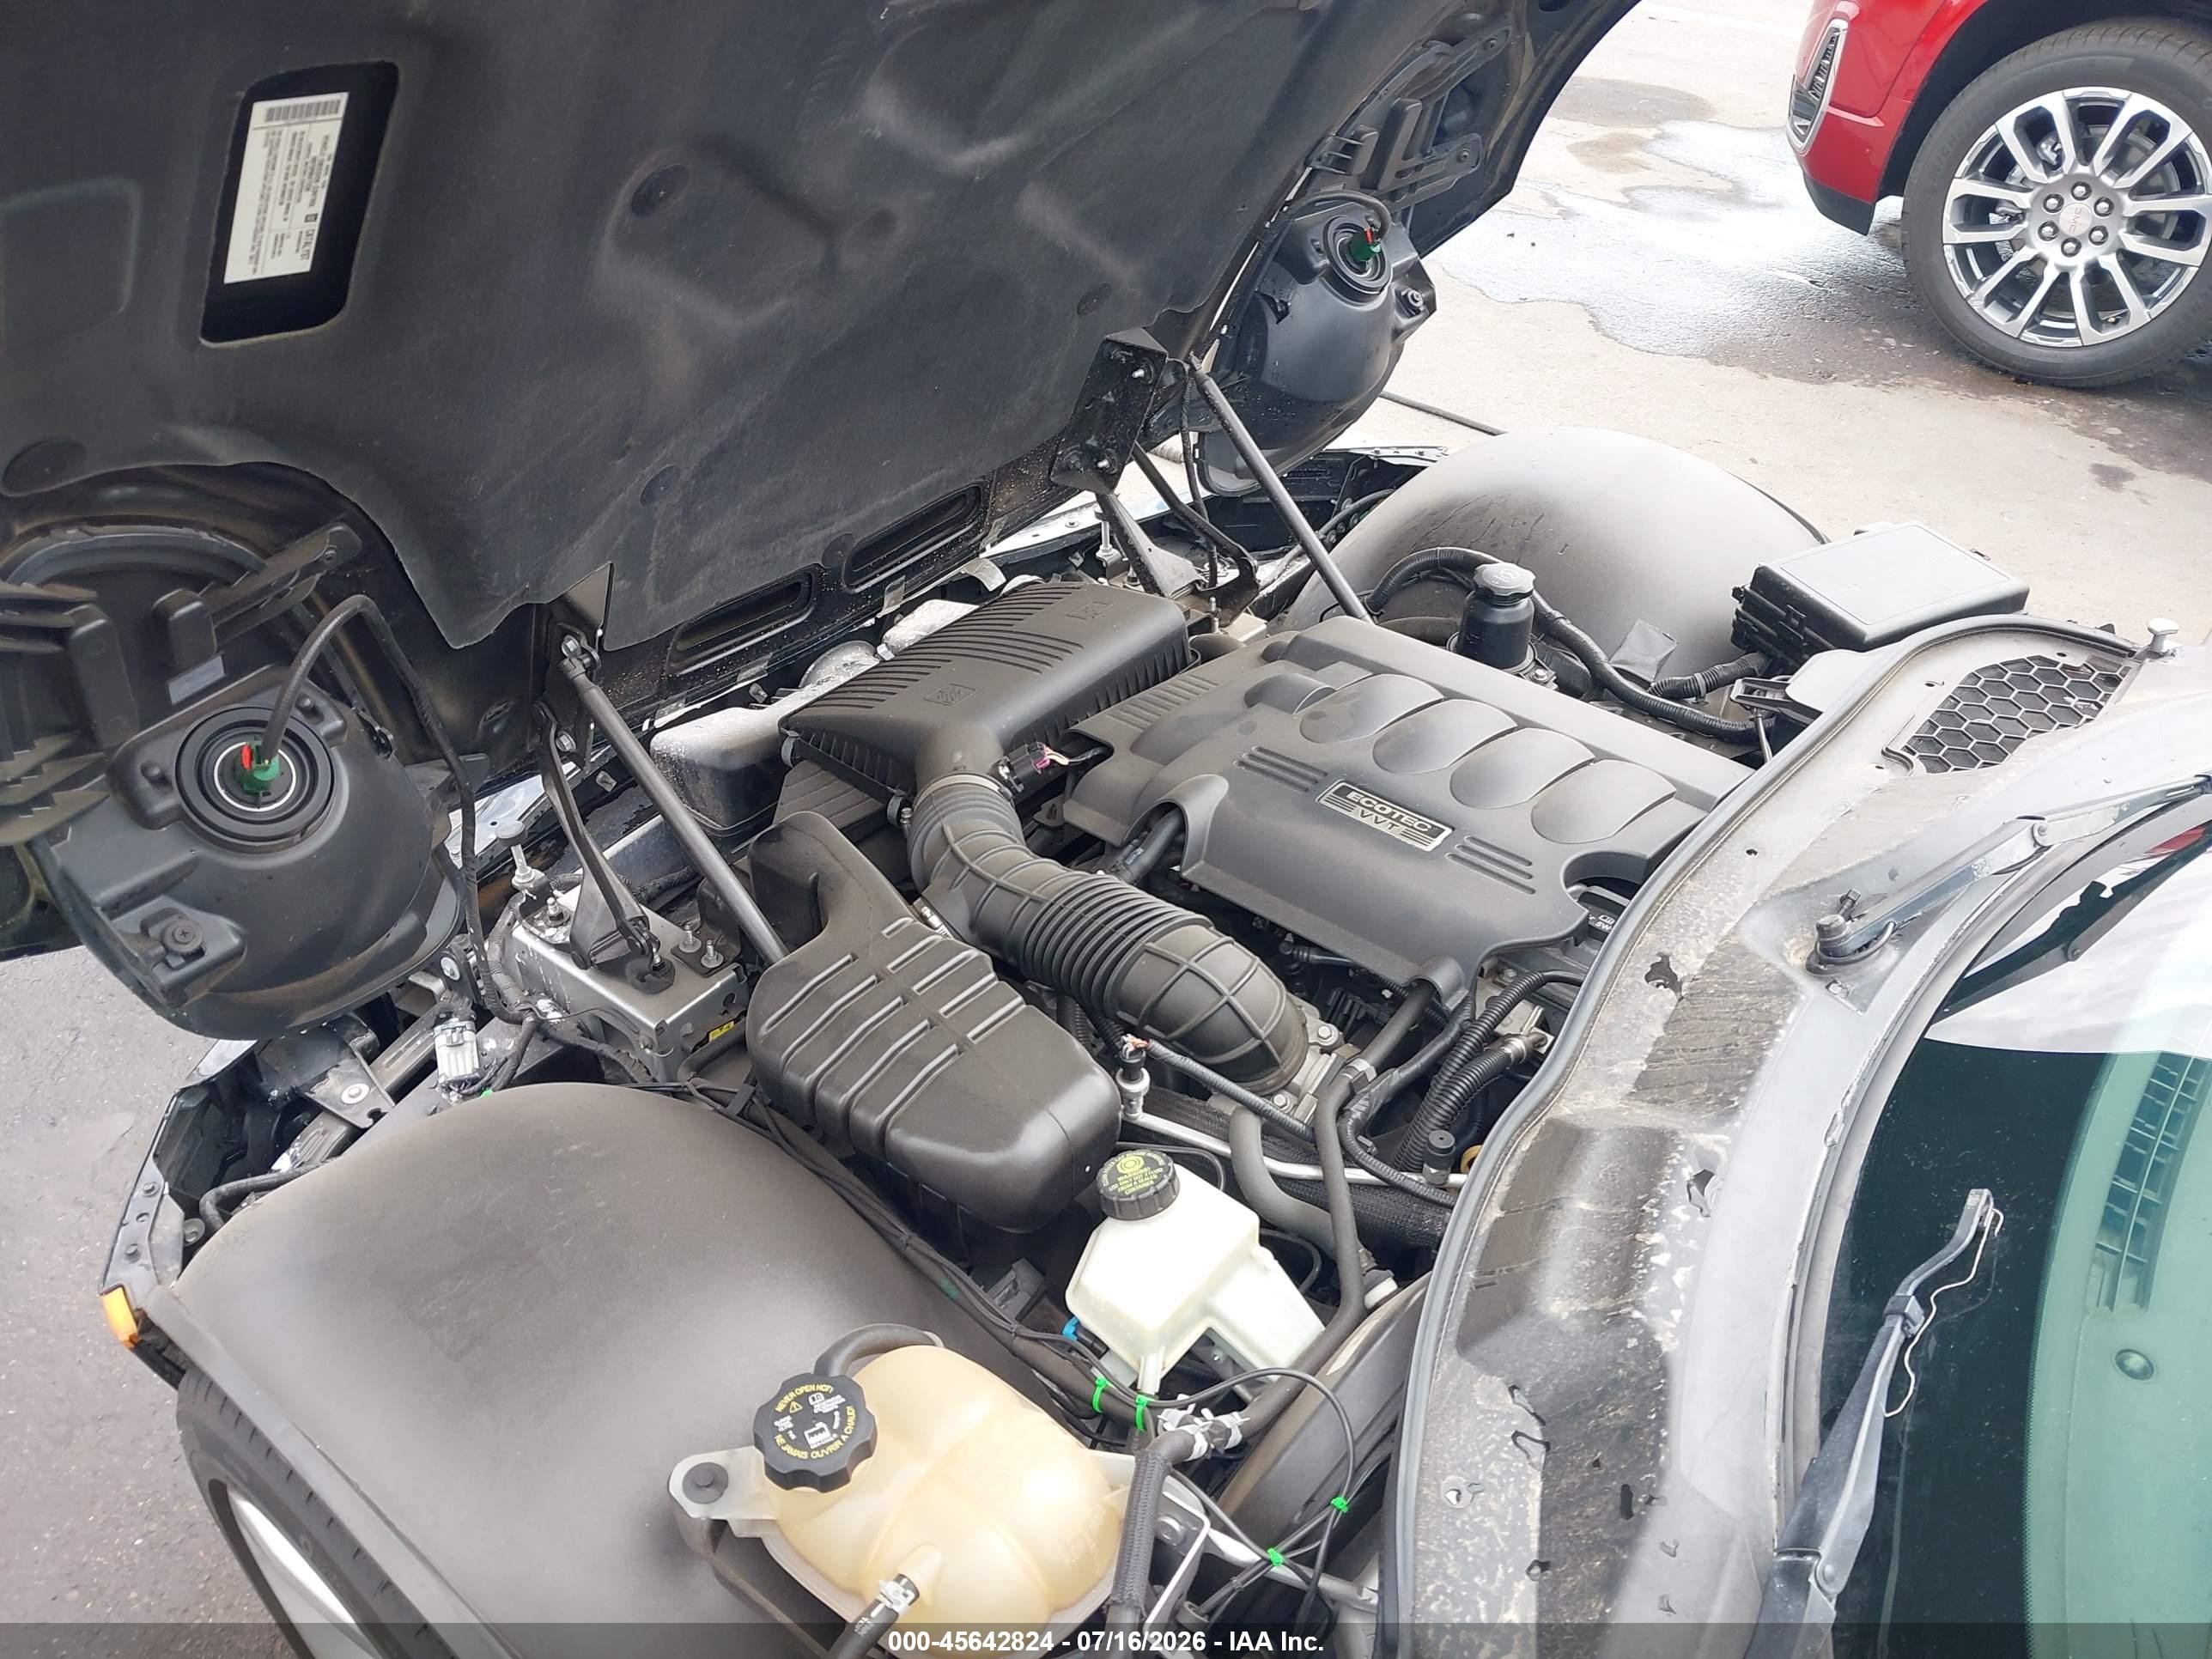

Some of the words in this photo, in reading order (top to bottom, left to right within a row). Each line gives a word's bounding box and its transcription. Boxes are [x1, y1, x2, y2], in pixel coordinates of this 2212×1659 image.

[1346, 791, 1431, 832] ECOTEC
[1358, 810, 1399, 830] VVT
[775, 1390, 795, 1413] NEVER
[794, 1384, 815, 1395] OPEN
[781, 1444, 808, 1459] JAMAIS
[810, 1439, 843, 1459] OUVRIR
